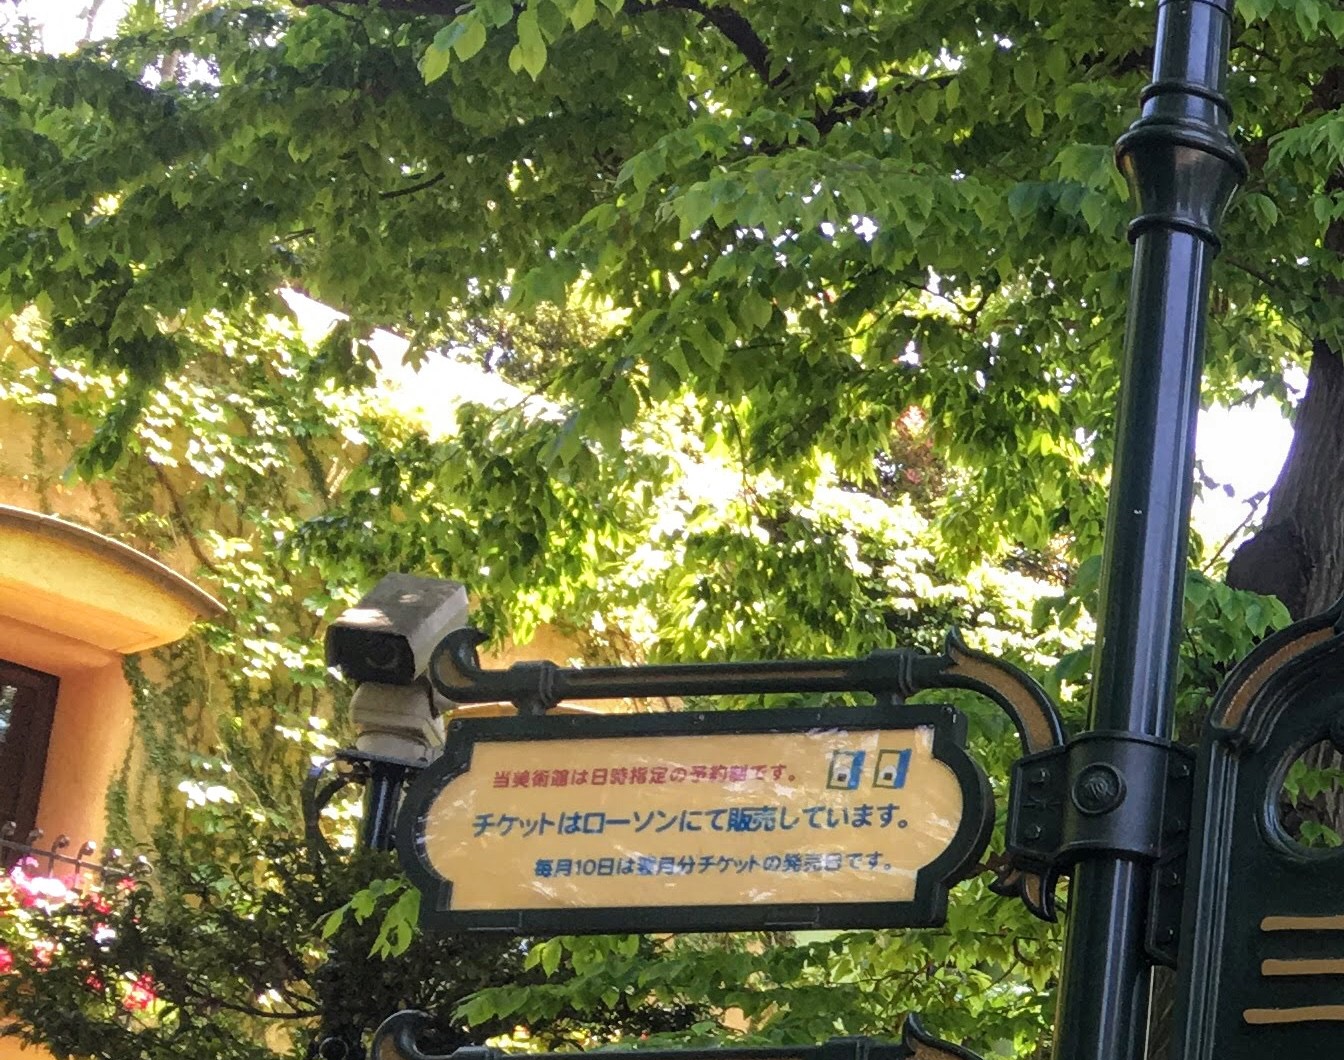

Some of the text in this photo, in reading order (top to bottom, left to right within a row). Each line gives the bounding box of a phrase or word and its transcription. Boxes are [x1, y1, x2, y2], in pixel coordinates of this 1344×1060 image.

[473, 805, 910, 838] チケットはローソンにて販売しています。
[534, 850, 893, 878] 毎月10日は翌月分チケットの発売日です。
